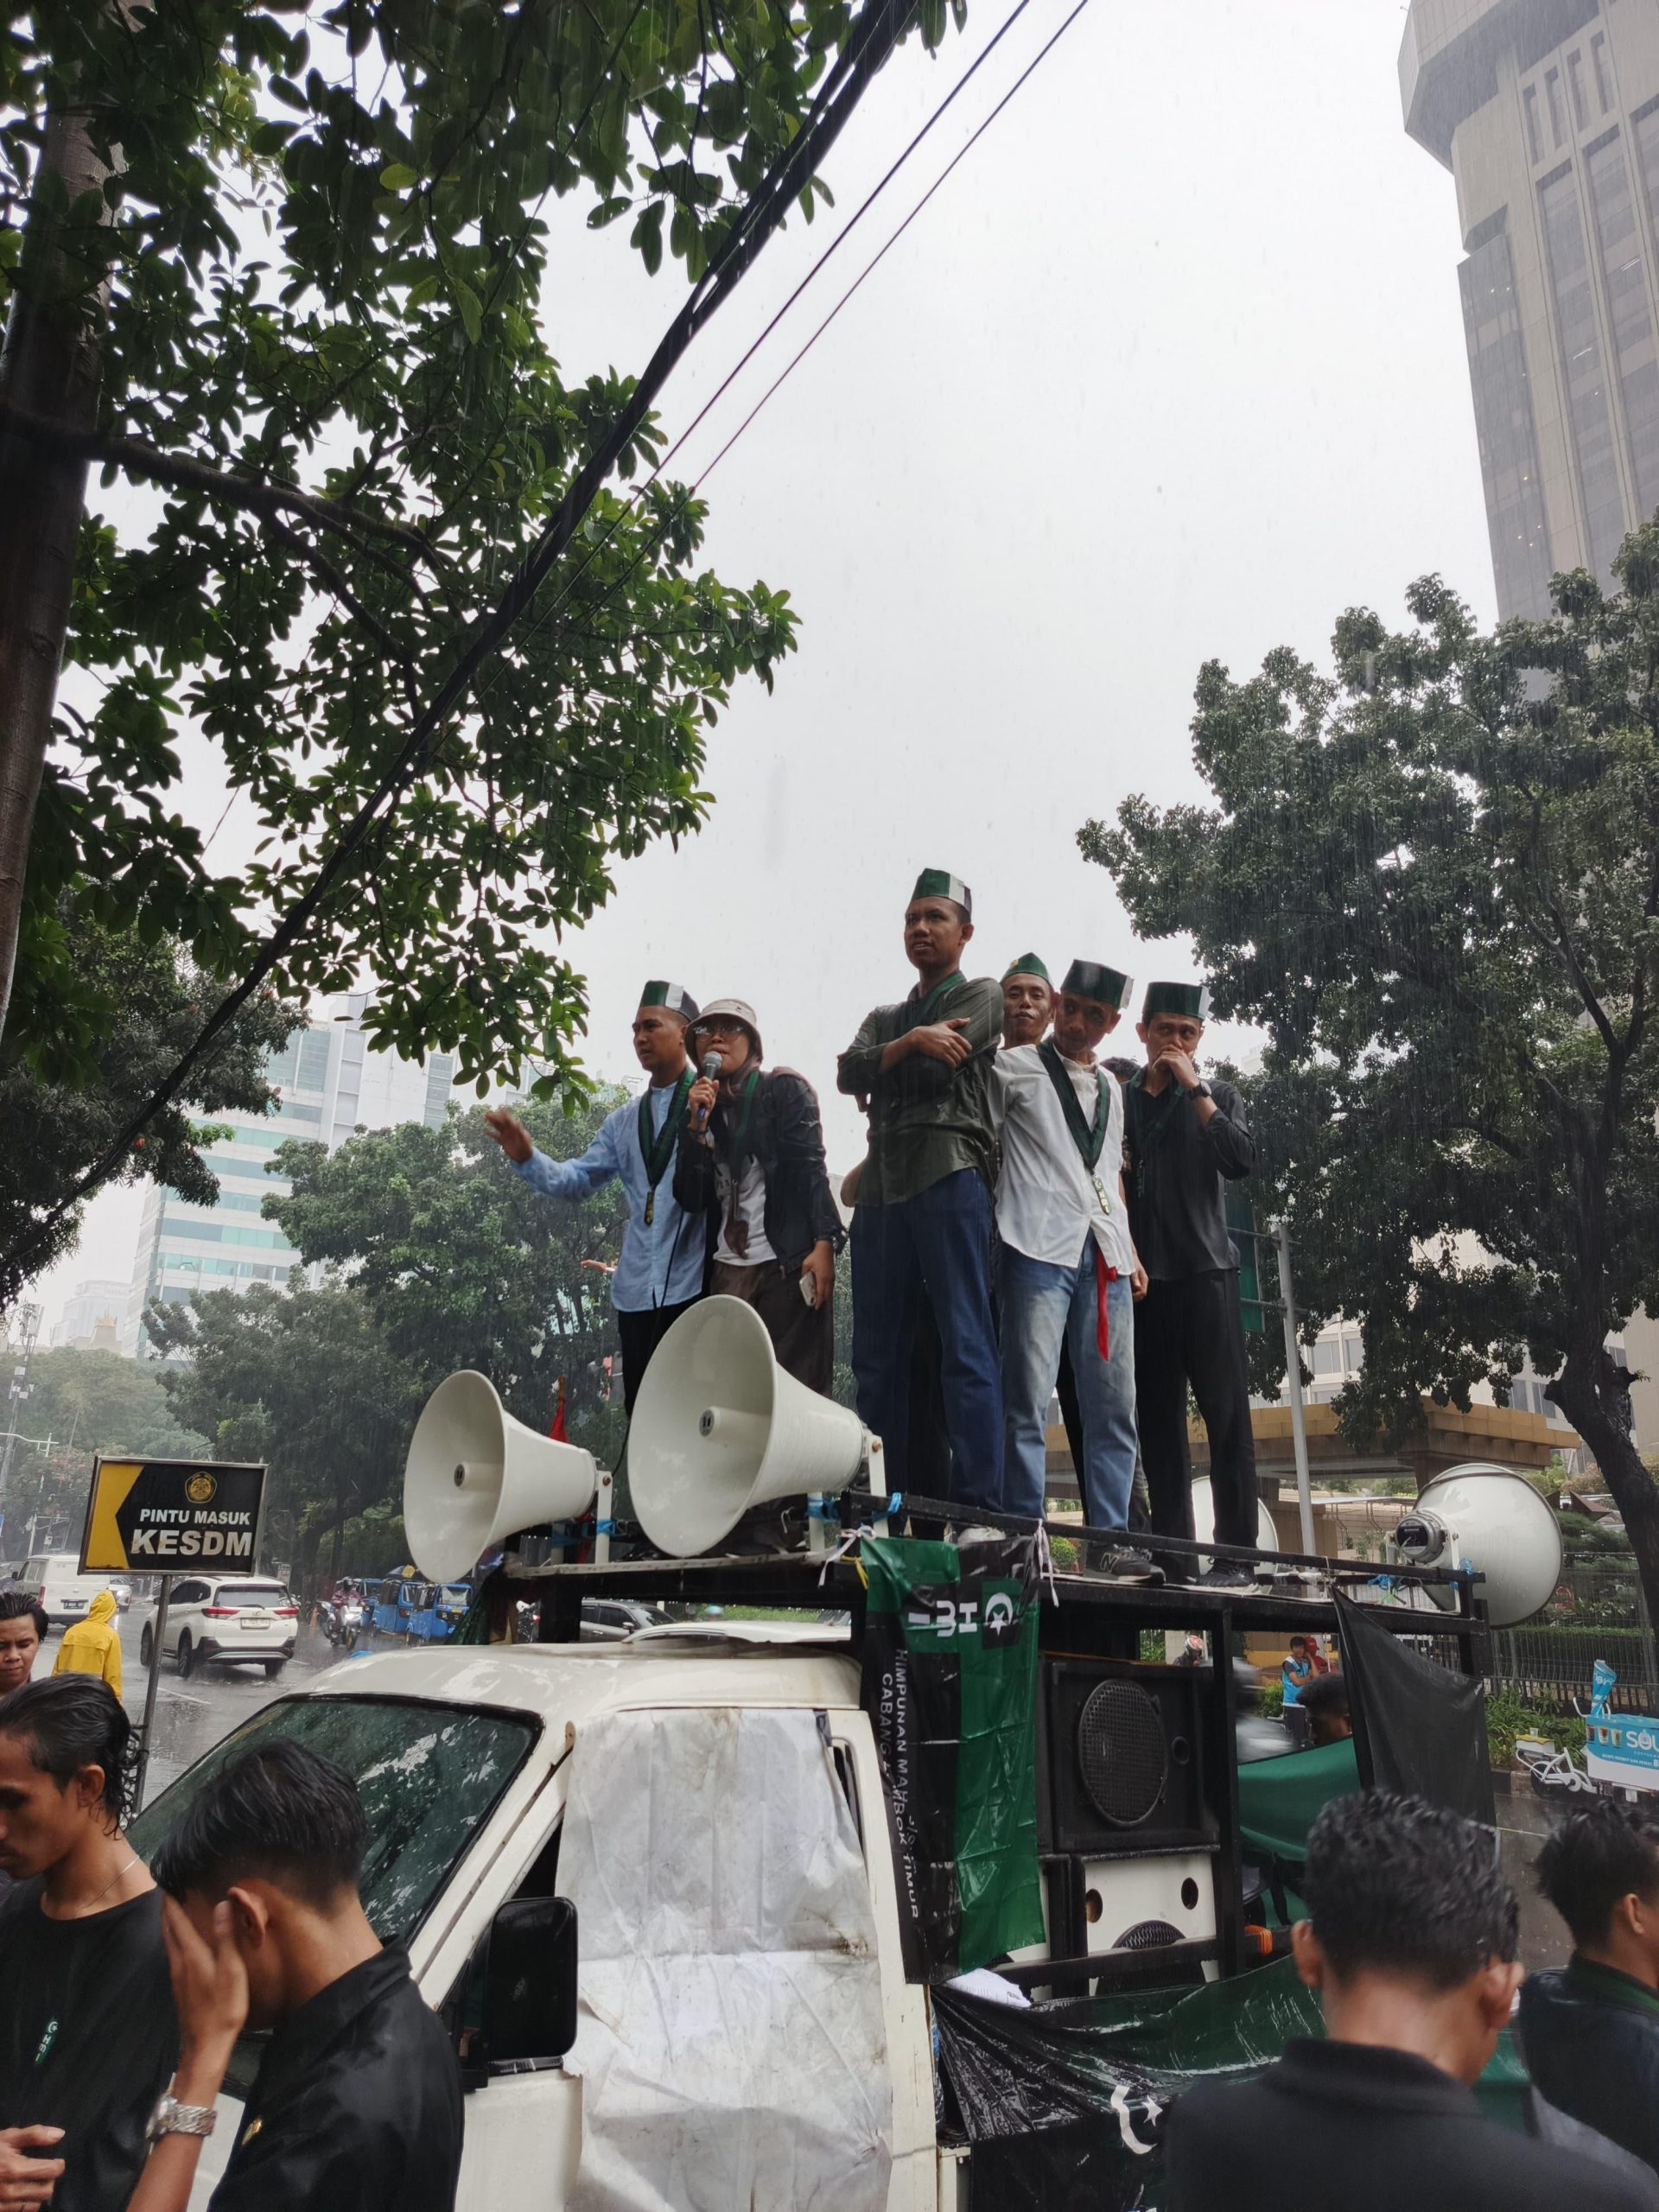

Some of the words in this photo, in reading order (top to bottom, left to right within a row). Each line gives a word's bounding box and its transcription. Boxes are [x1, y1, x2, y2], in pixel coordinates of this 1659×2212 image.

[130, 1529, 252, 1556] KESDM
[139, 1509, 190, 1523] PINTU
[194, 1510, 251, 1525] MASUK
[895, 1649, 908, 1751] HIMPUNAN
[880, 1673, 893, 1755] CABANG
[903, 1853, 918, 1918] TIMUR
